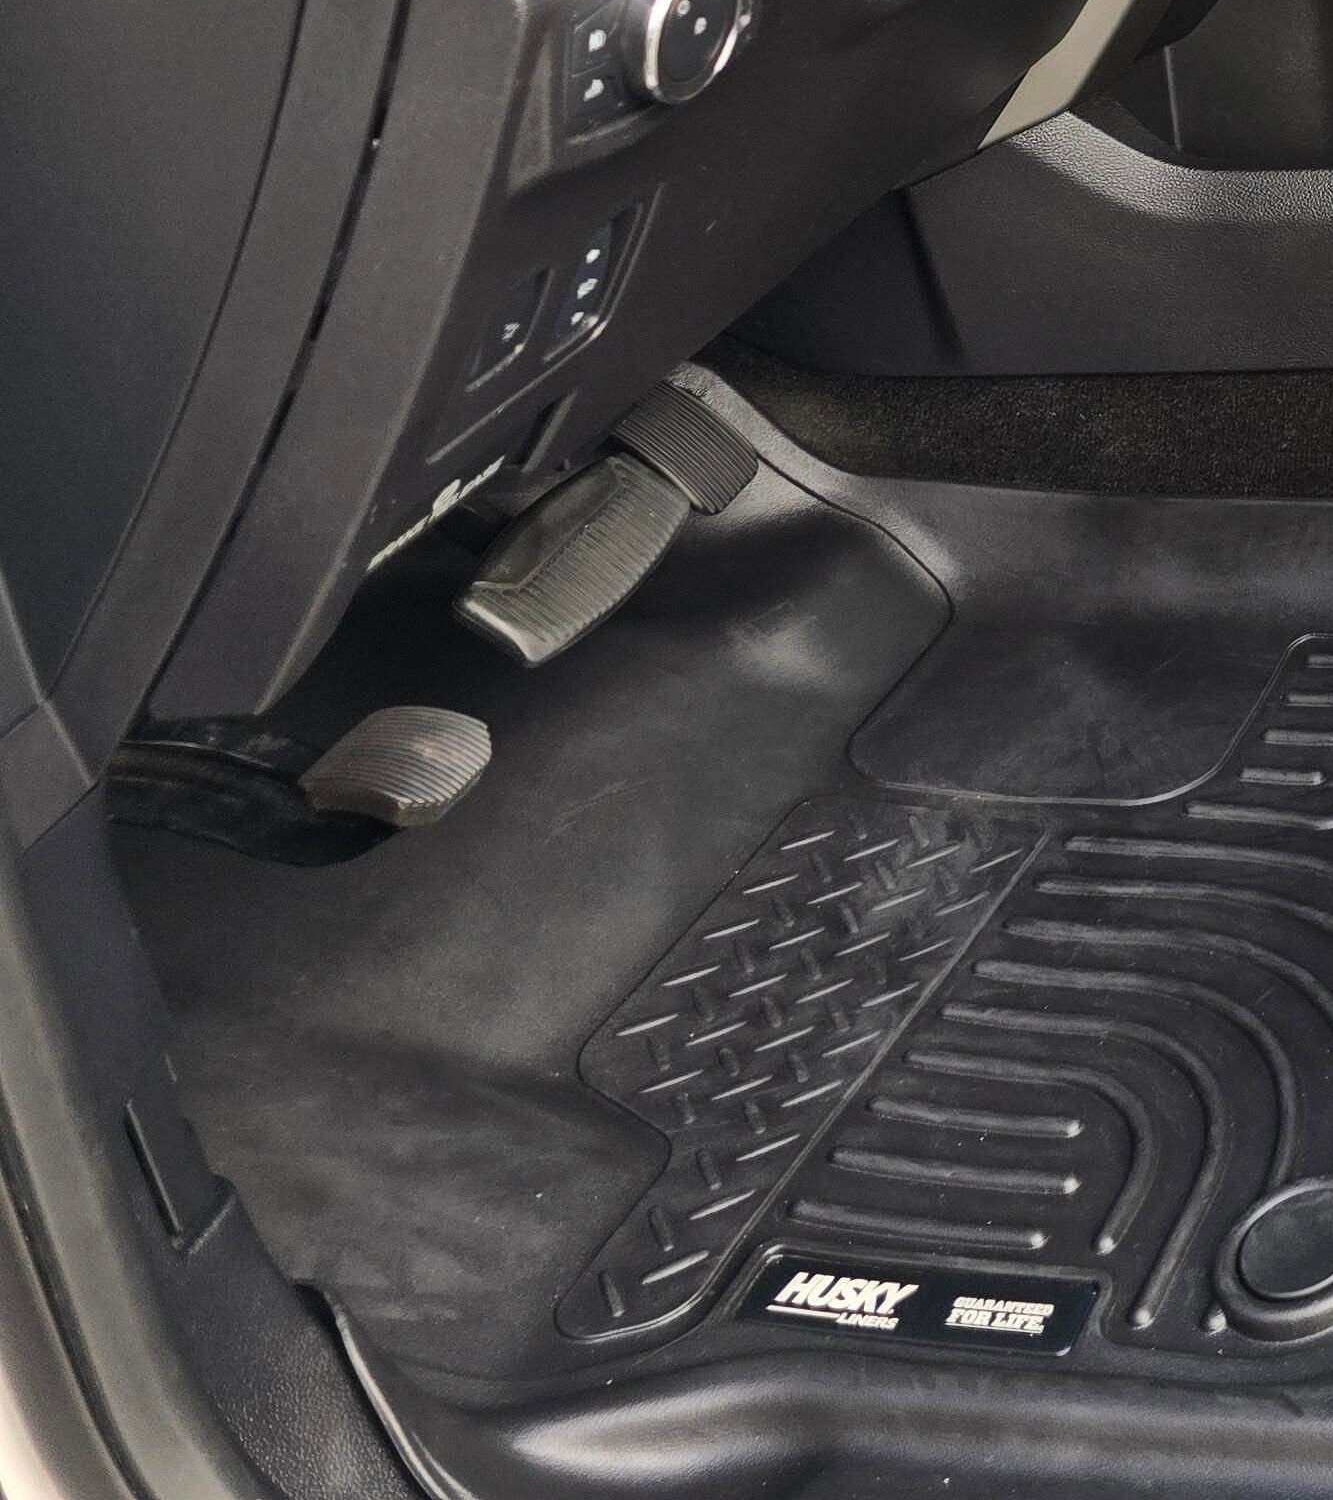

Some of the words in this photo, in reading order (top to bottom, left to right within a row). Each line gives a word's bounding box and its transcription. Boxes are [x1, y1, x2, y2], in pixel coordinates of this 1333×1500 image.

[773, 1271, 919, 1315] HUSKY
[952, 1296, 1055, 1317] GUARANTEED
[836, 1312, 899, 1331] LINERS
[946, 1308, 992, 1326] FOR
